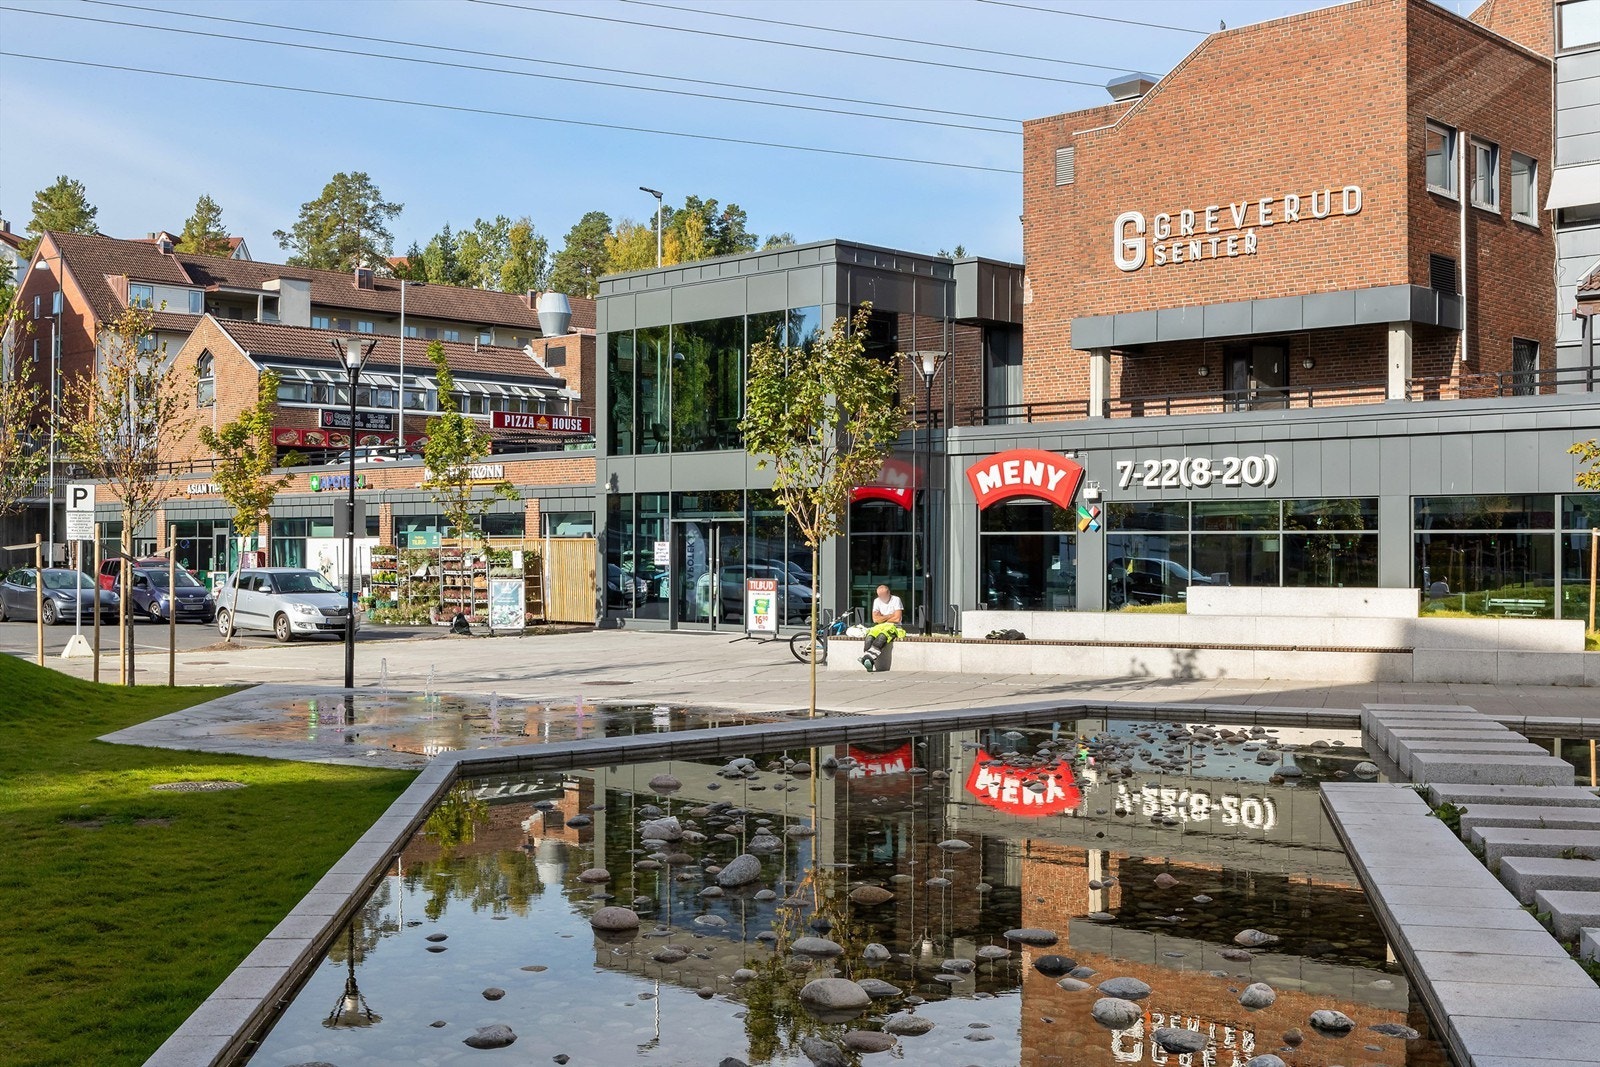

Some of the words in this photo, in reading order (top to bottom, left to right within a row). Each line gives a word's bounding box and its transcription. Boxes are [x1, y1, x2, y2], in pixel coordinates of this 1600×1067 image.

[1154, 185, 1363, 240] GREVERUD
[1113, 210, 1147, 272] G
[1153, 231, 1258, 267] SENTER
[504, 414, 534, 428] PIZZA
[552, 417, 582, 431] HOUSE
[976, 459, 1067, 495] MENY
[1116, 453, 1279, 488] 7-22(8-20)
[73, 487, 88, 508] P
[187, 483, 207, 494] ASIAN
[749, 580, 774, 590] TILBUD
